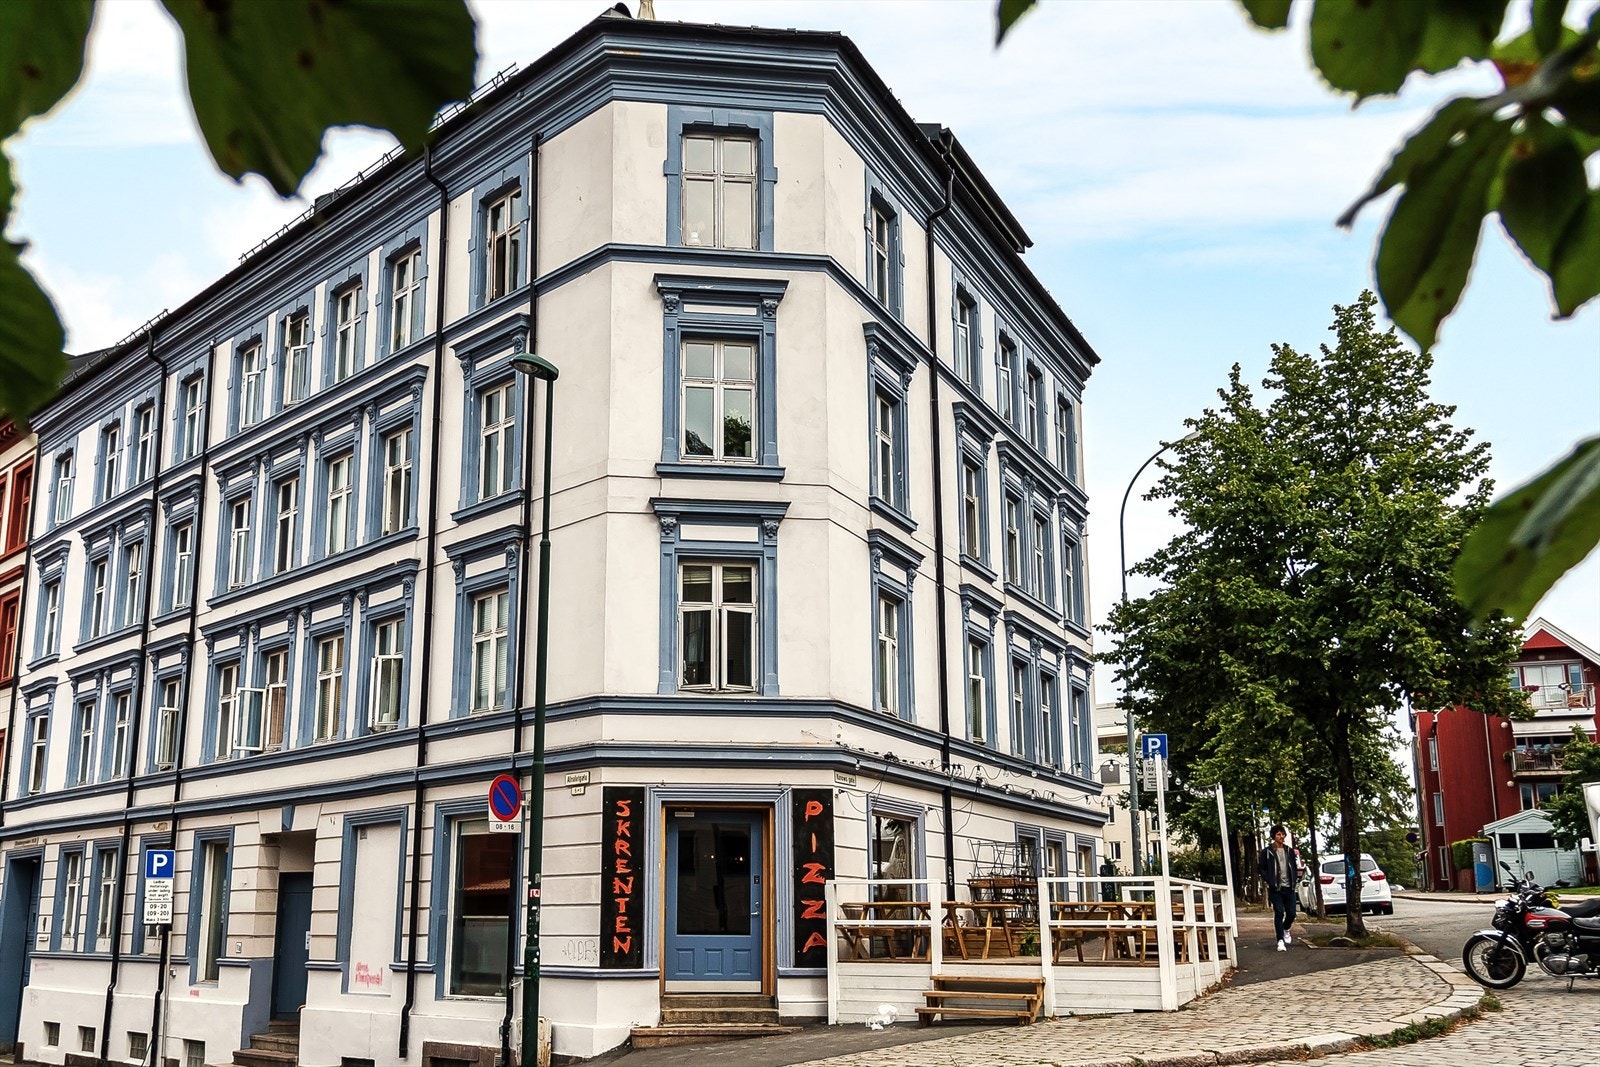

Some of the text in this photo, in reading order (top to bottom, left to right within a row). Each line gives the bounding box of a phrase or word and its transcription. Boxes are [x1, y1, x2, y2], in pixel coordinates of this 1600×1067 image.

[1148, 738, 1161, 756] P
[153, 854, 168, 875] P
[612, 800, 634, 954] SKRENTEN
[801, 800, 827, 953] PIZZA
